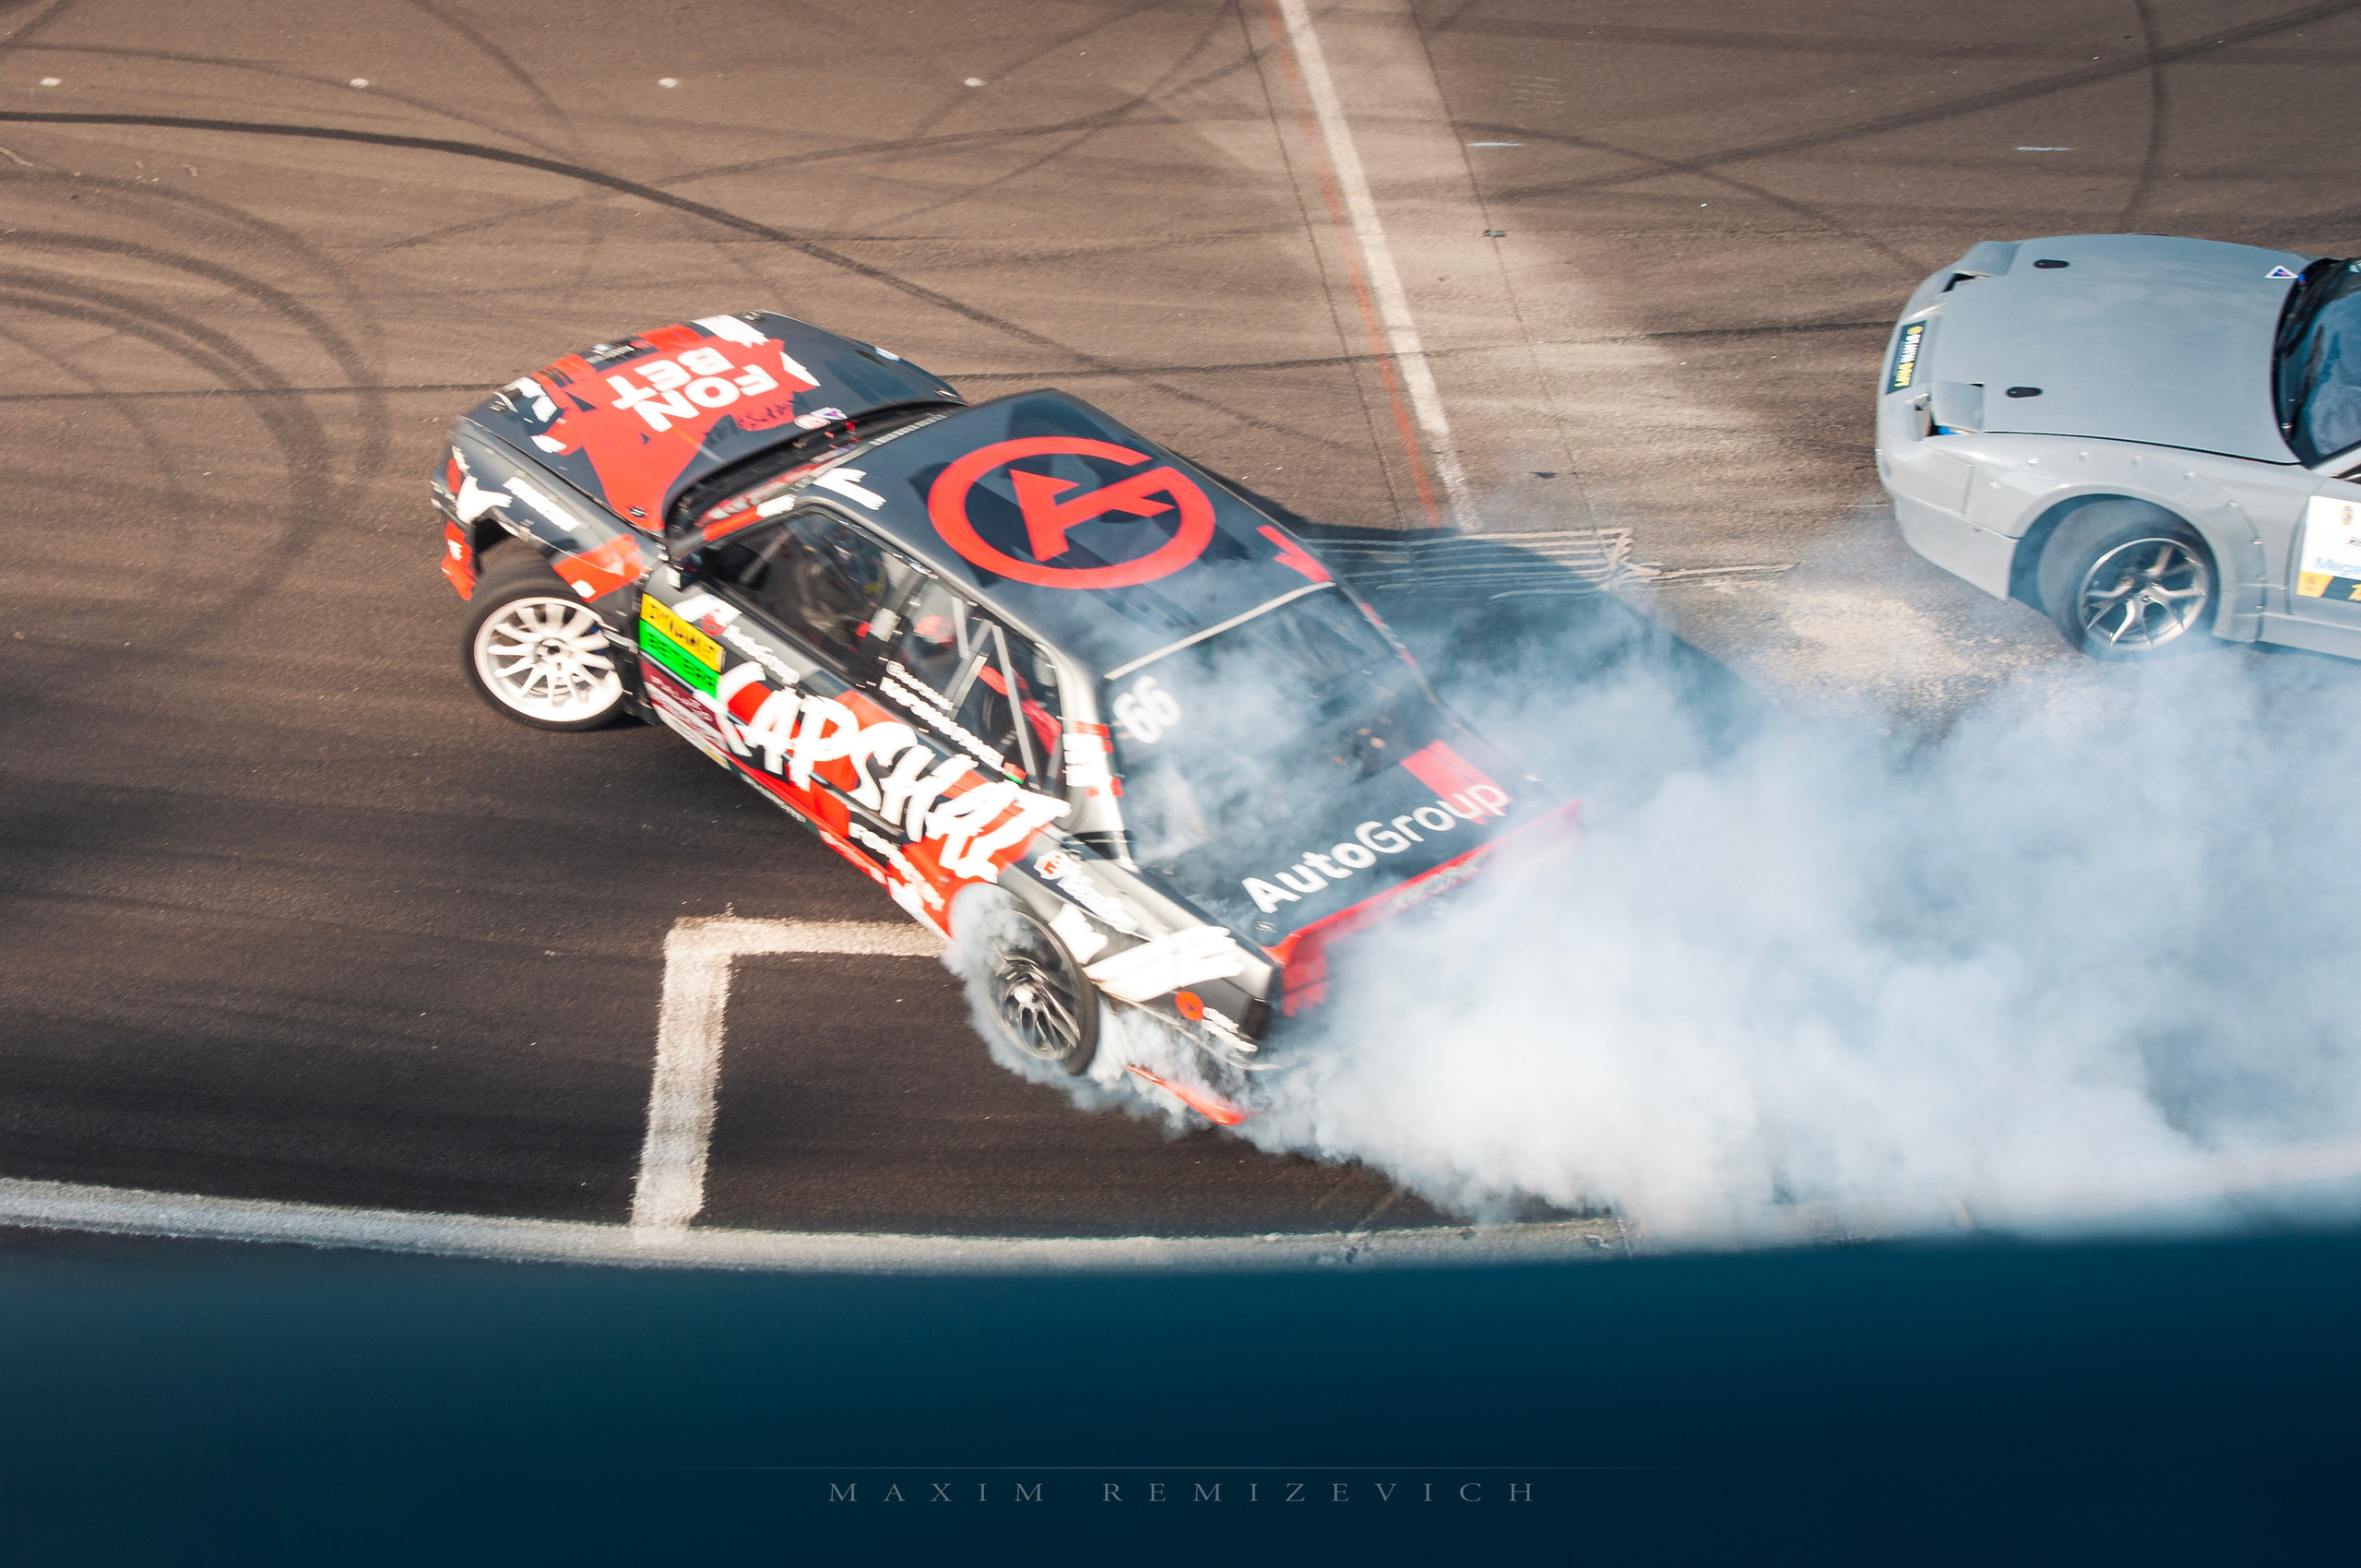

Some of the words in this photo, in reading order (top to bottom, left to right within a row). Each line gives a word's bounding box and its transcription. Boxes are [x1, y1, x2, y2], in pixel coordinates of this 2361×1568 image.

[605, 346, 736, 410] BET
[633, 363, 779, 433] FON
[1111, 674, 1182, 744] 66
[1240, 783, 1511, 914] AutoGroup
